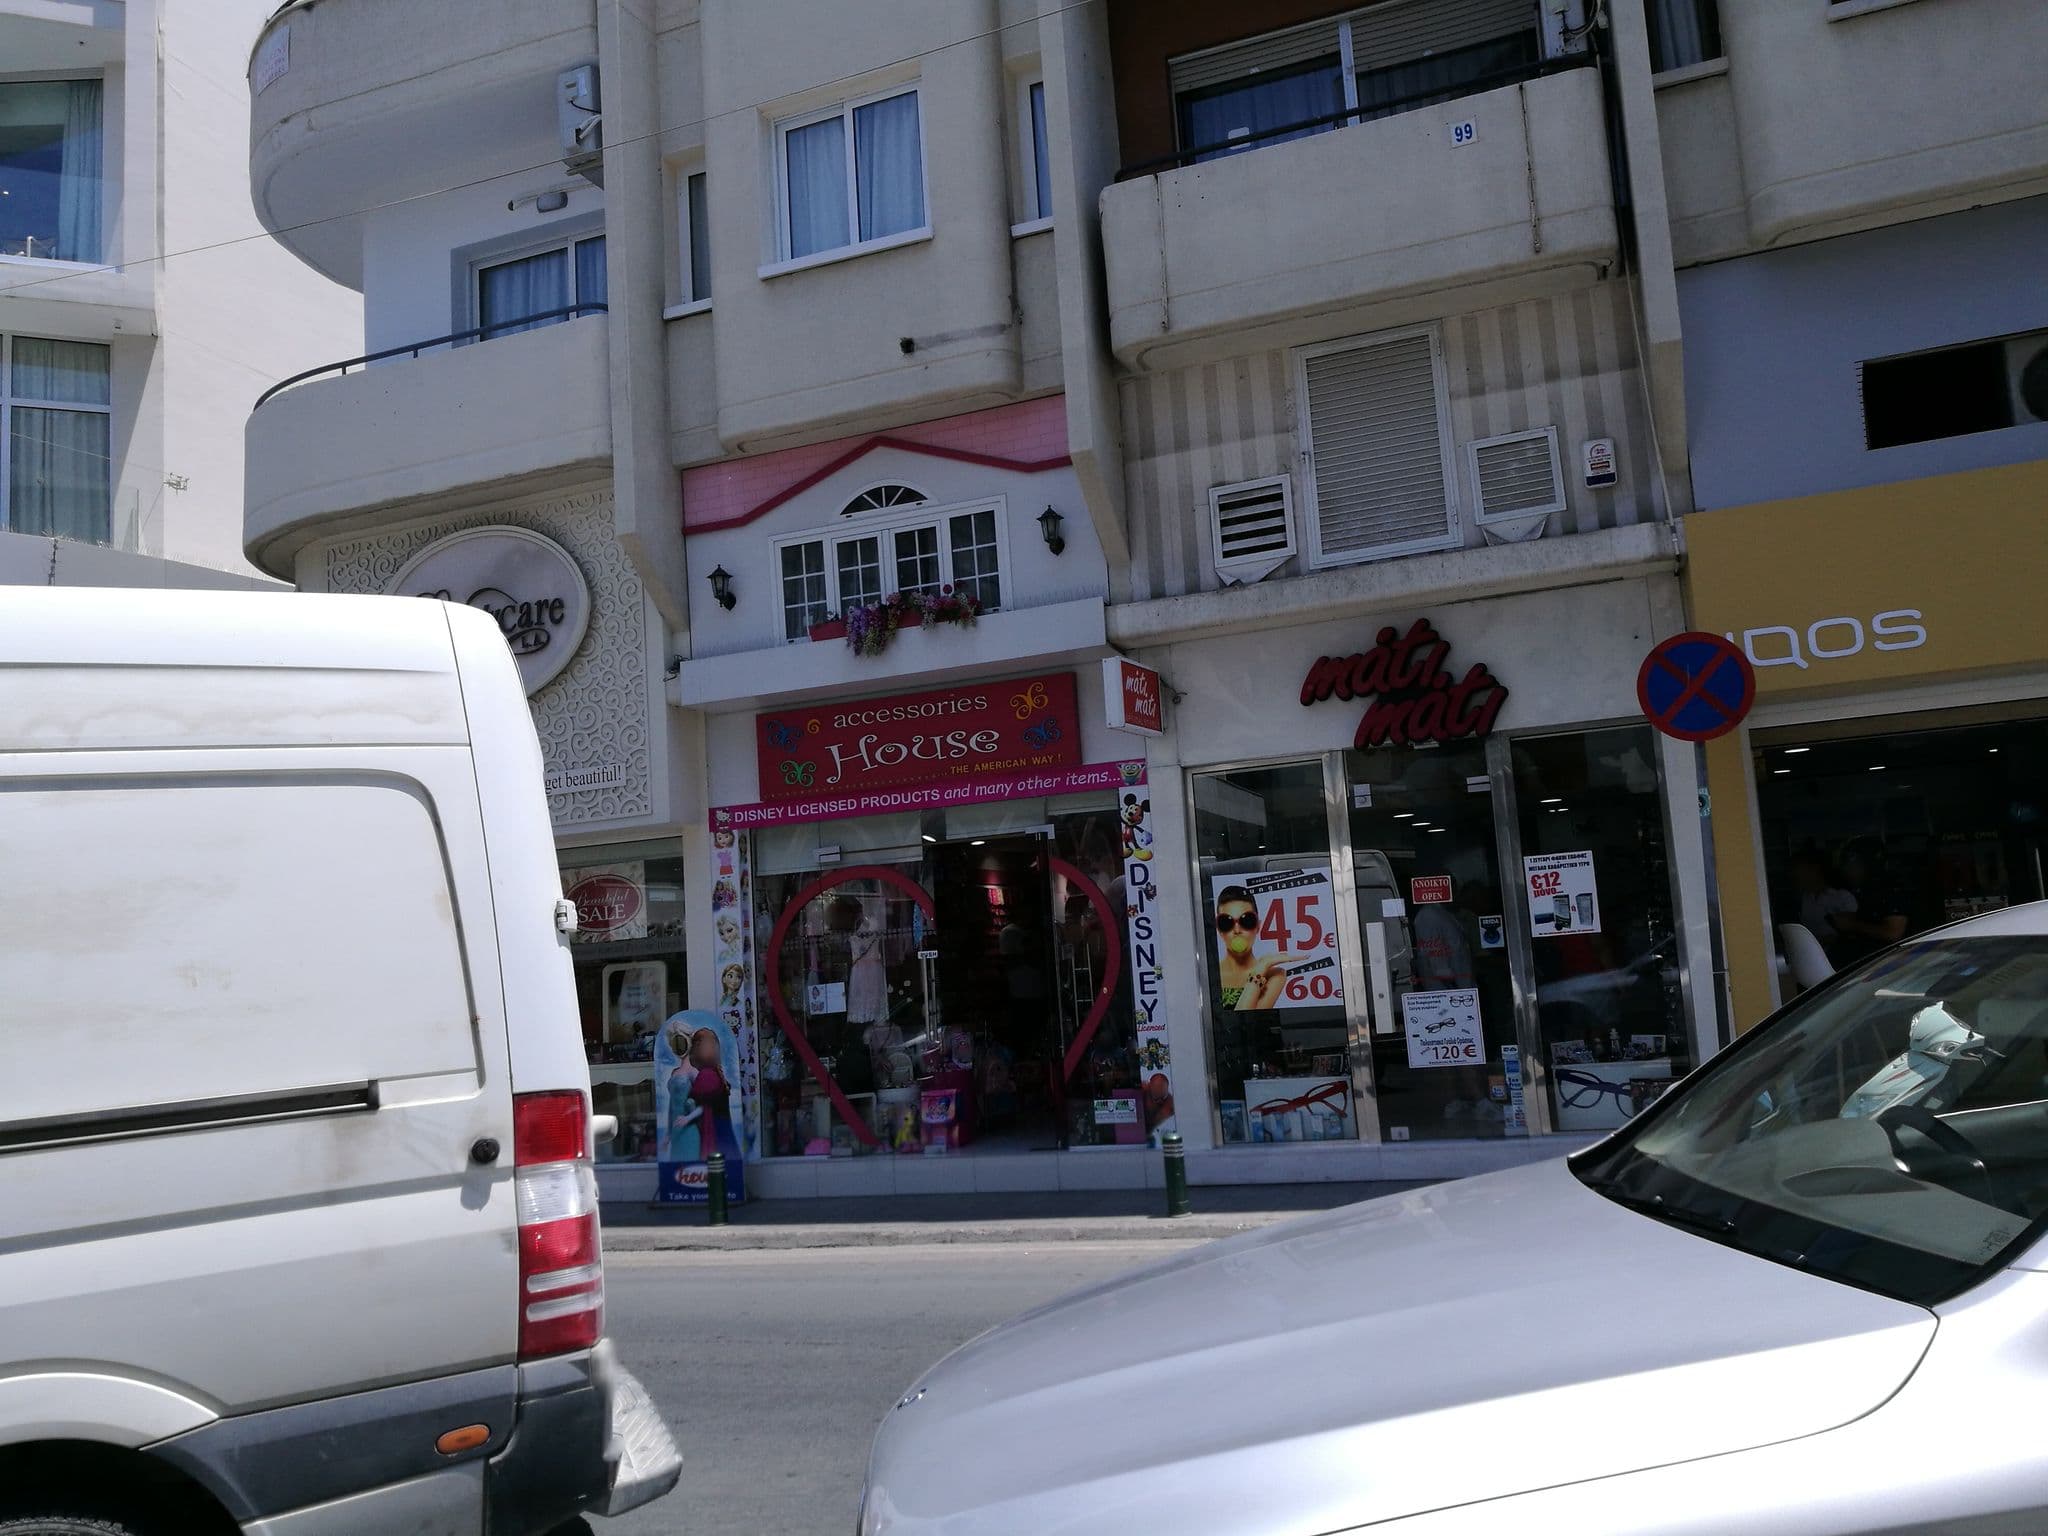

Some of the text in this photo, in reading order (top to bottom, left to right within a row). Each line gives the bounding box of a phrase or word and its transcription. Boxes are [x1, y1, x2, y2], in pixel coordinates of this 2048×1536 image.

[1454, 122, 1473, 143] 99
[833, 694, 988, 728] accessories
[824, 729, 1000, 784] House
[950, 765, 969, 775] THE
[974, 758, 1027, 773] AMERICAN
[1032, 755, 1054, 766] WAY
[545, 765, 622, 795] get beautiful!
[735, 807, 784, 822] DISNEY
[788, 799, 857, 817] LICENSED
[861, 789, 940, 809] PRODUCTS
[944, 784, 971, 800] and
[975, 782, 1014, 797] many
[1017, 776, 1061, 791] other
[1242, 877, 1317, 895] sunglasses
[1531, 871, 1561, 889] €12
[1422, 892, 1443, 901] OPEN
[578, 904, 626, 924] SALE
[1130, 863, 1158, 1022] DISNEY
[1432, 1045, 1460, 1060] 120
[668, 1192, 689, 1200] Take
